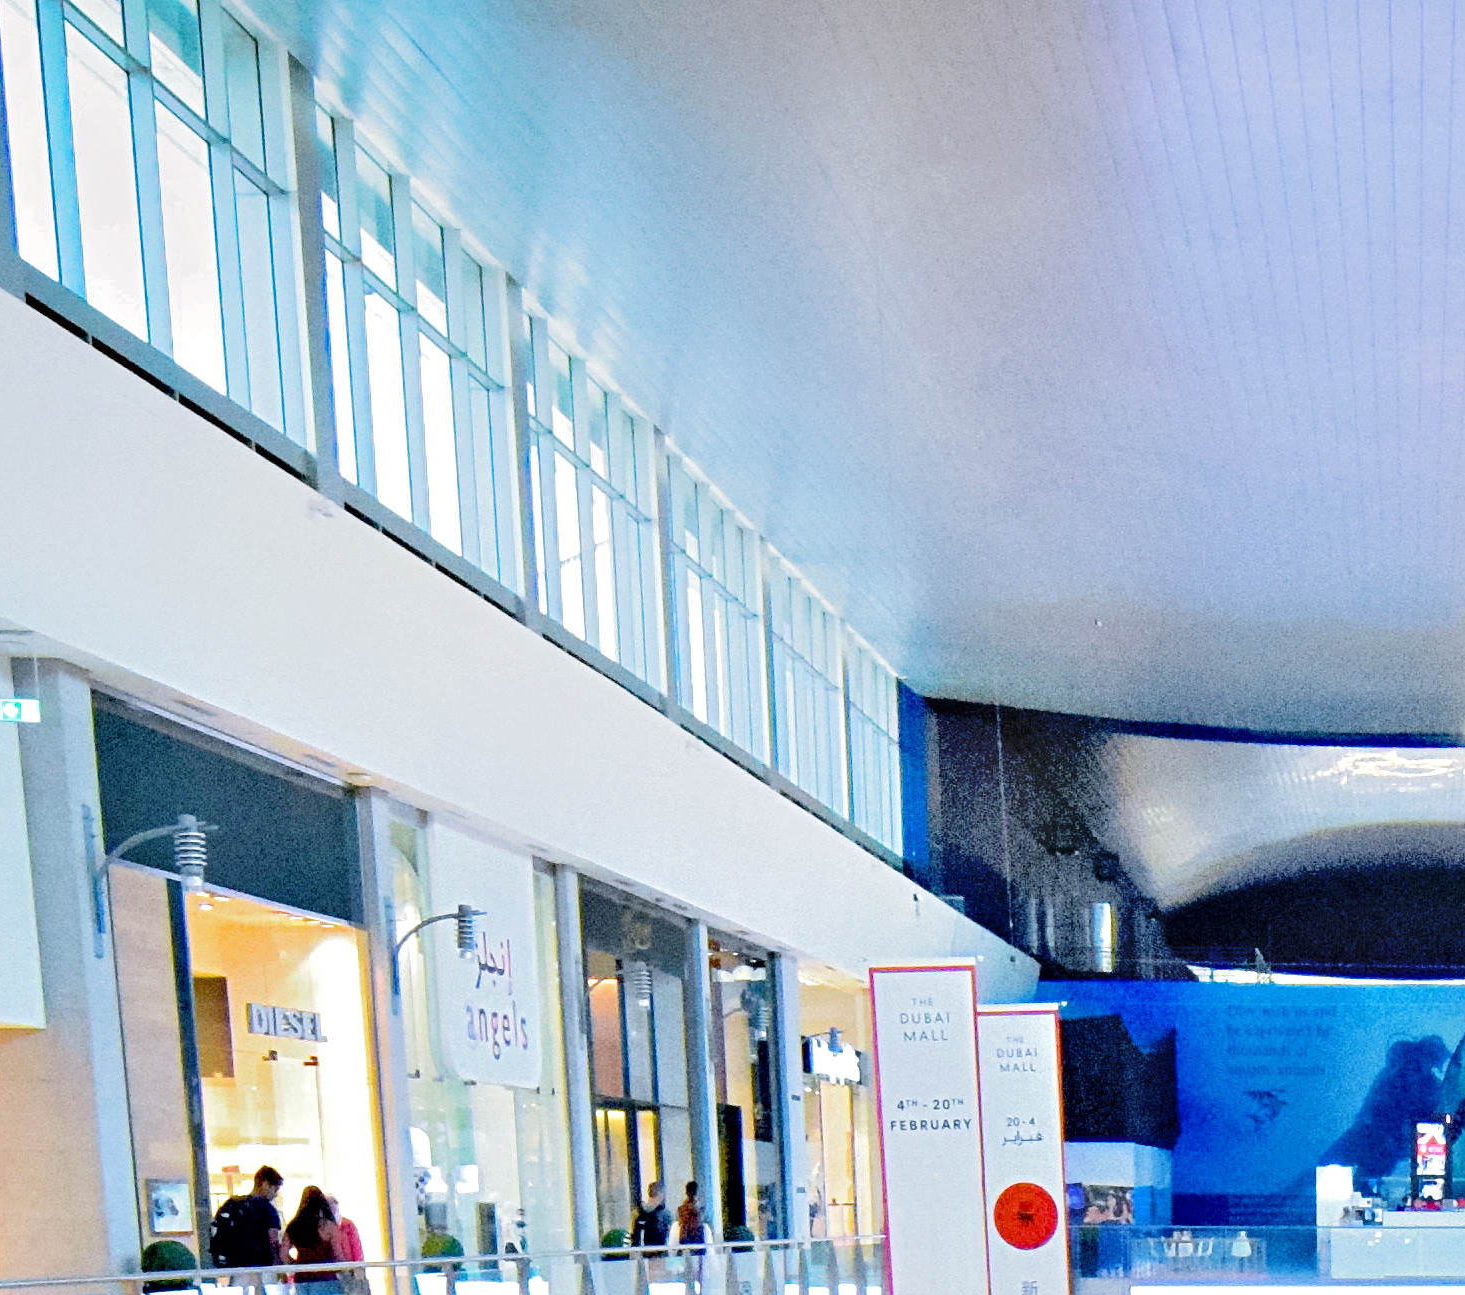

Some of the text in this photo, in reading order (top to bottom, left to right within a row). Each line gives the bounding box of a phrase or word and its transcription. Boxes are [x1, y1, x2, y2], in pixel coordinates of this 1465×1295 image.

[911, 997, 934, 1007] THE
[246, 1003, 327, 1042] DIESEL
[900, 1012, 950, 1025] DUBAI
[466, 1000, 528, 1060] angels
[903, 1029, 948, 1042] MALL
[996, 1047, 1038, 1059] DUBAI
[999, 1062, 1037, 1073] MALL
[897, 1098, 918, 1111] 4TH
[933, 1098, 964, 1111] 20TH
[890, 1119, 972, 1132] FEBRUARY
